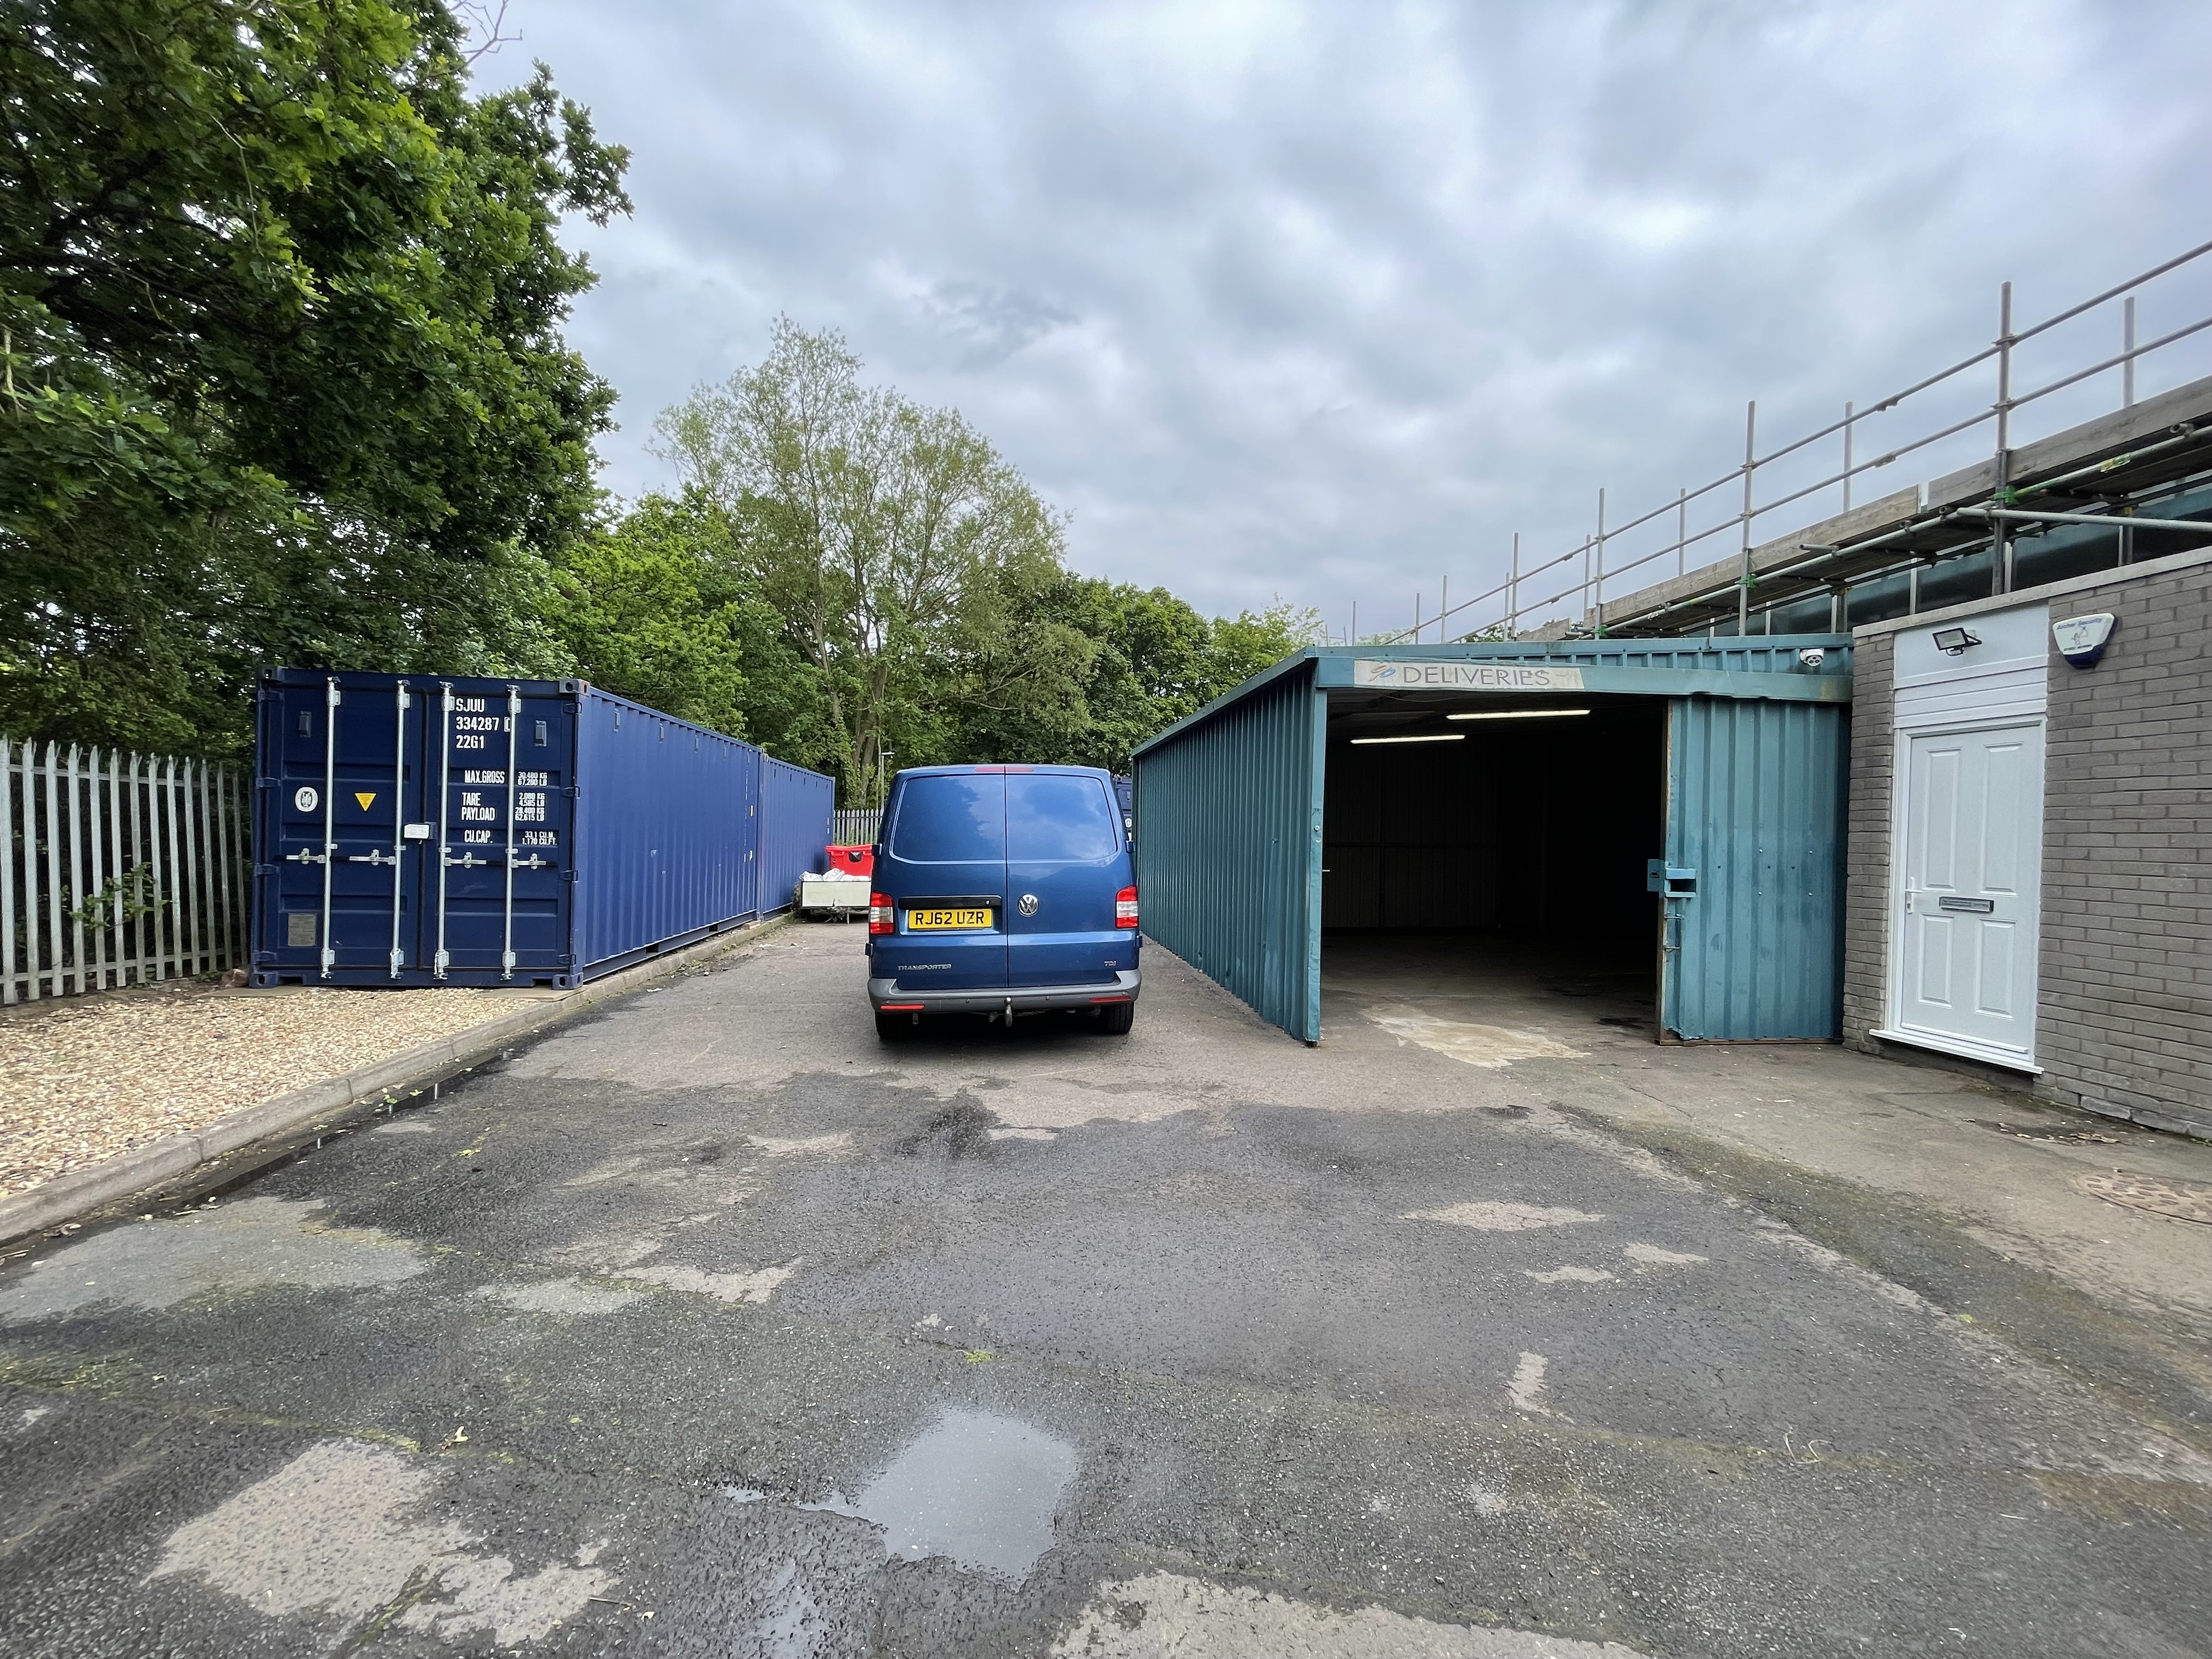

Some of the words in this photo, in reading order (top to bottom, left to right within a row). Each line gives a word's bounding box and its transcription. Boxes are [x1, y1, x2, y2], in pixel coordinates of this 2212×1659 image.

[1403, 666, 1550, 686] DELIVERIES
[456, 698, 485, 712] SJUU
[456, 716, 499, 731] 334287
[456, 735, 484, 749] 22G1
[464, 770, 505, 783] MAX.GROSS
[462, 792, 481, 806] TARE
[461, 806, 495, 821] PAYLOAD
[464, 830, 493, 844] CU.CAP.
[915, 912, 952, 926] RJ62
[957, 911, 985, 924] UZR
